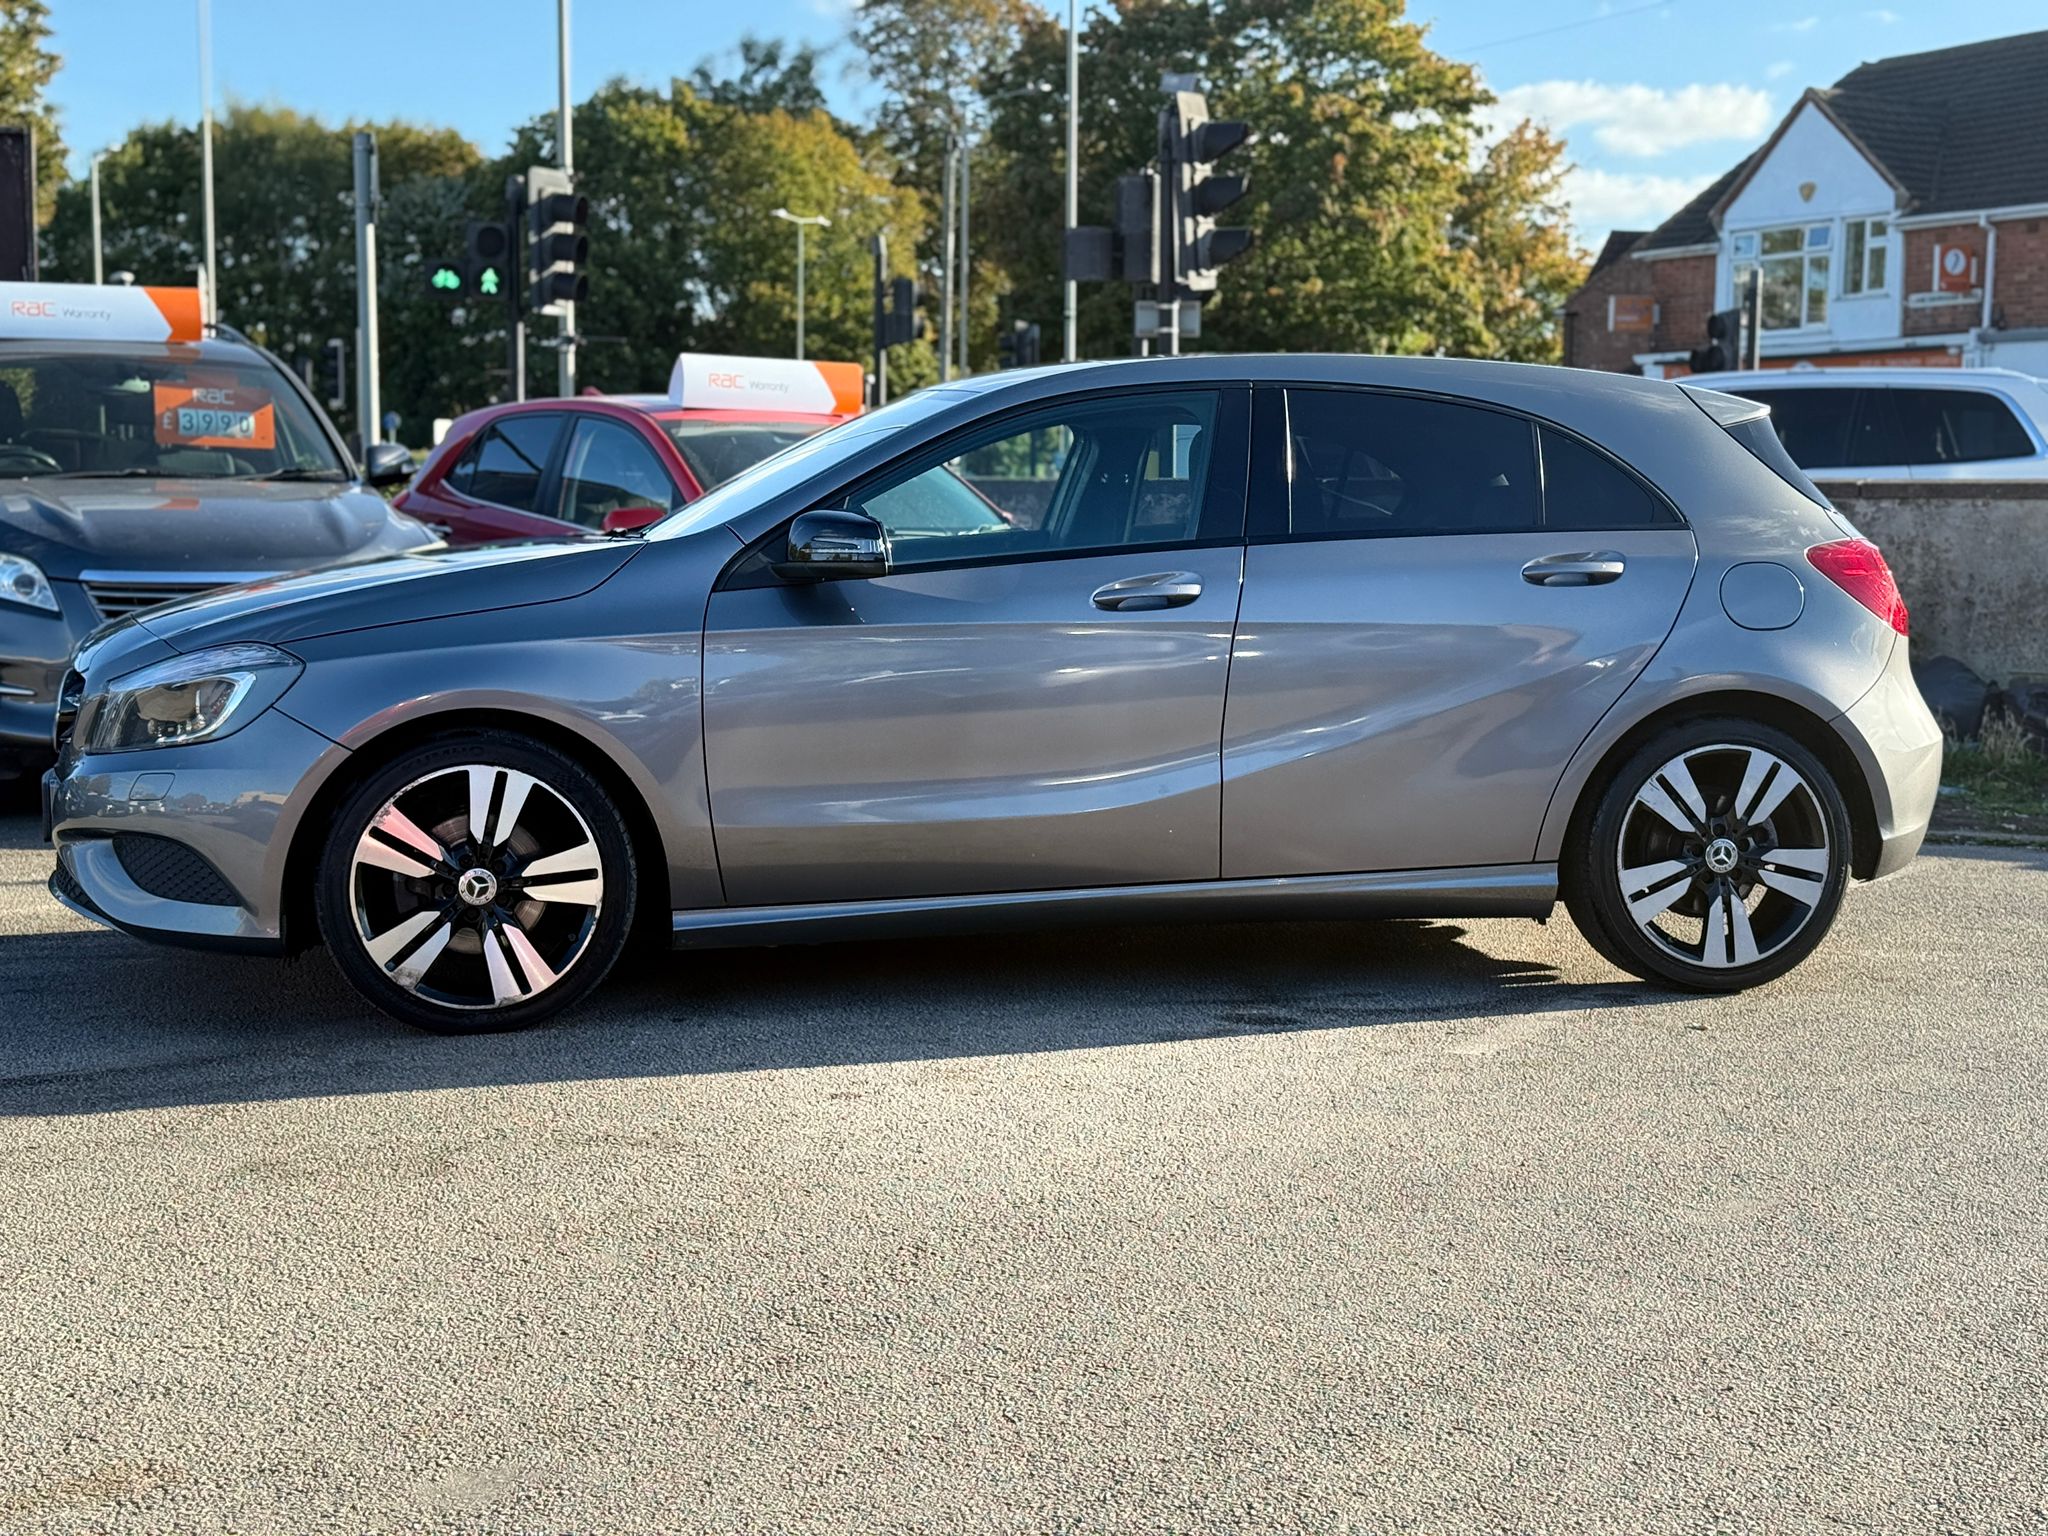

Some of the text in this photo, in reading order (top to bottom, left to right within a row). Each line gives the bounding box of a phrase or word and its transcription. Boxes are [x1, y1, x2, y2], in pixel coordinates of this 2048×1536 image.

[62, 307, 112, 321] Warranty
[749, 380, 789, 394] Warranty
[182, 412, 250, 434] 3990
